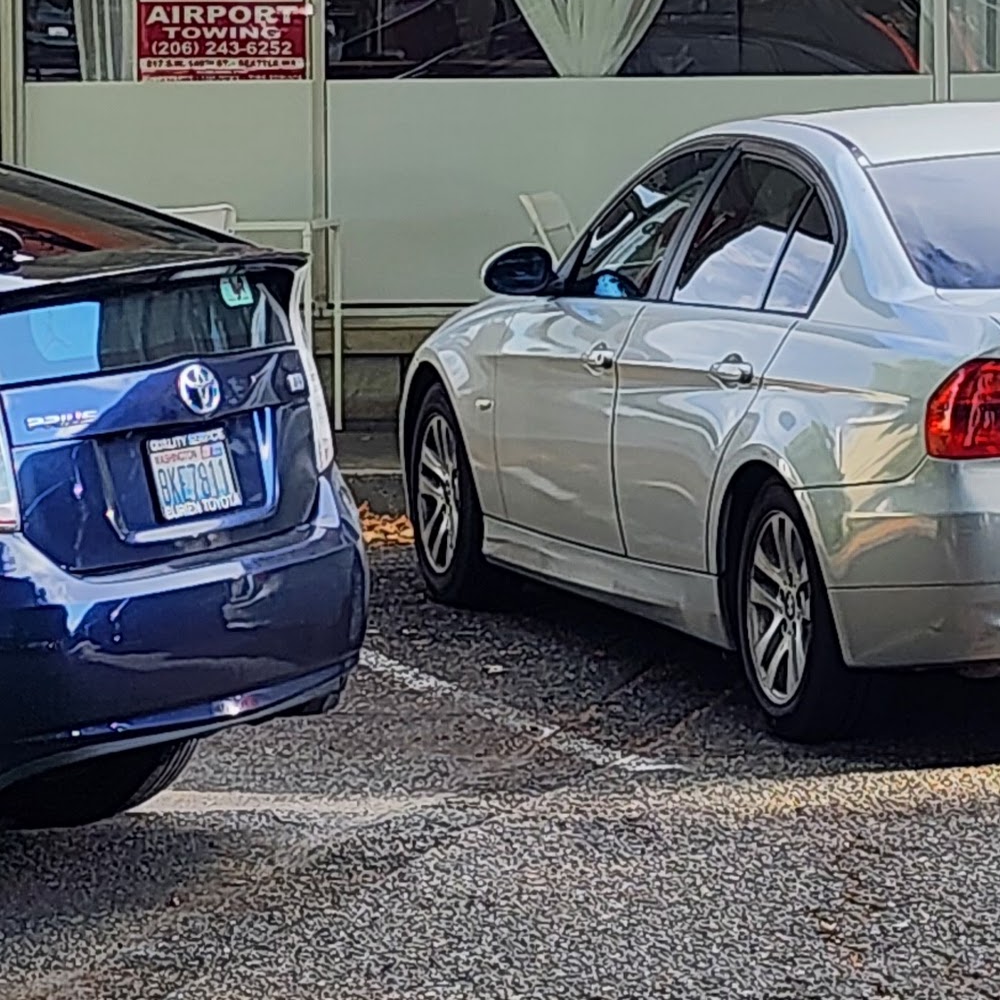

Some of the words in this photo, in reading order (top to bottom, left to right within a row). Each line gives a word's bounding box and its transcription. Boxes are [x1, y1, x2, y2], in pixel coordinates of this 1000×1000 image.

[146, 5, 299, 25] AIRPORT
[162, 26, 281, 40] TOWING
[151, 41, 199, 56] (206)
[205, 41, 292, 55] 243-6252
[201, 493, 242, 512] TOYOTA
